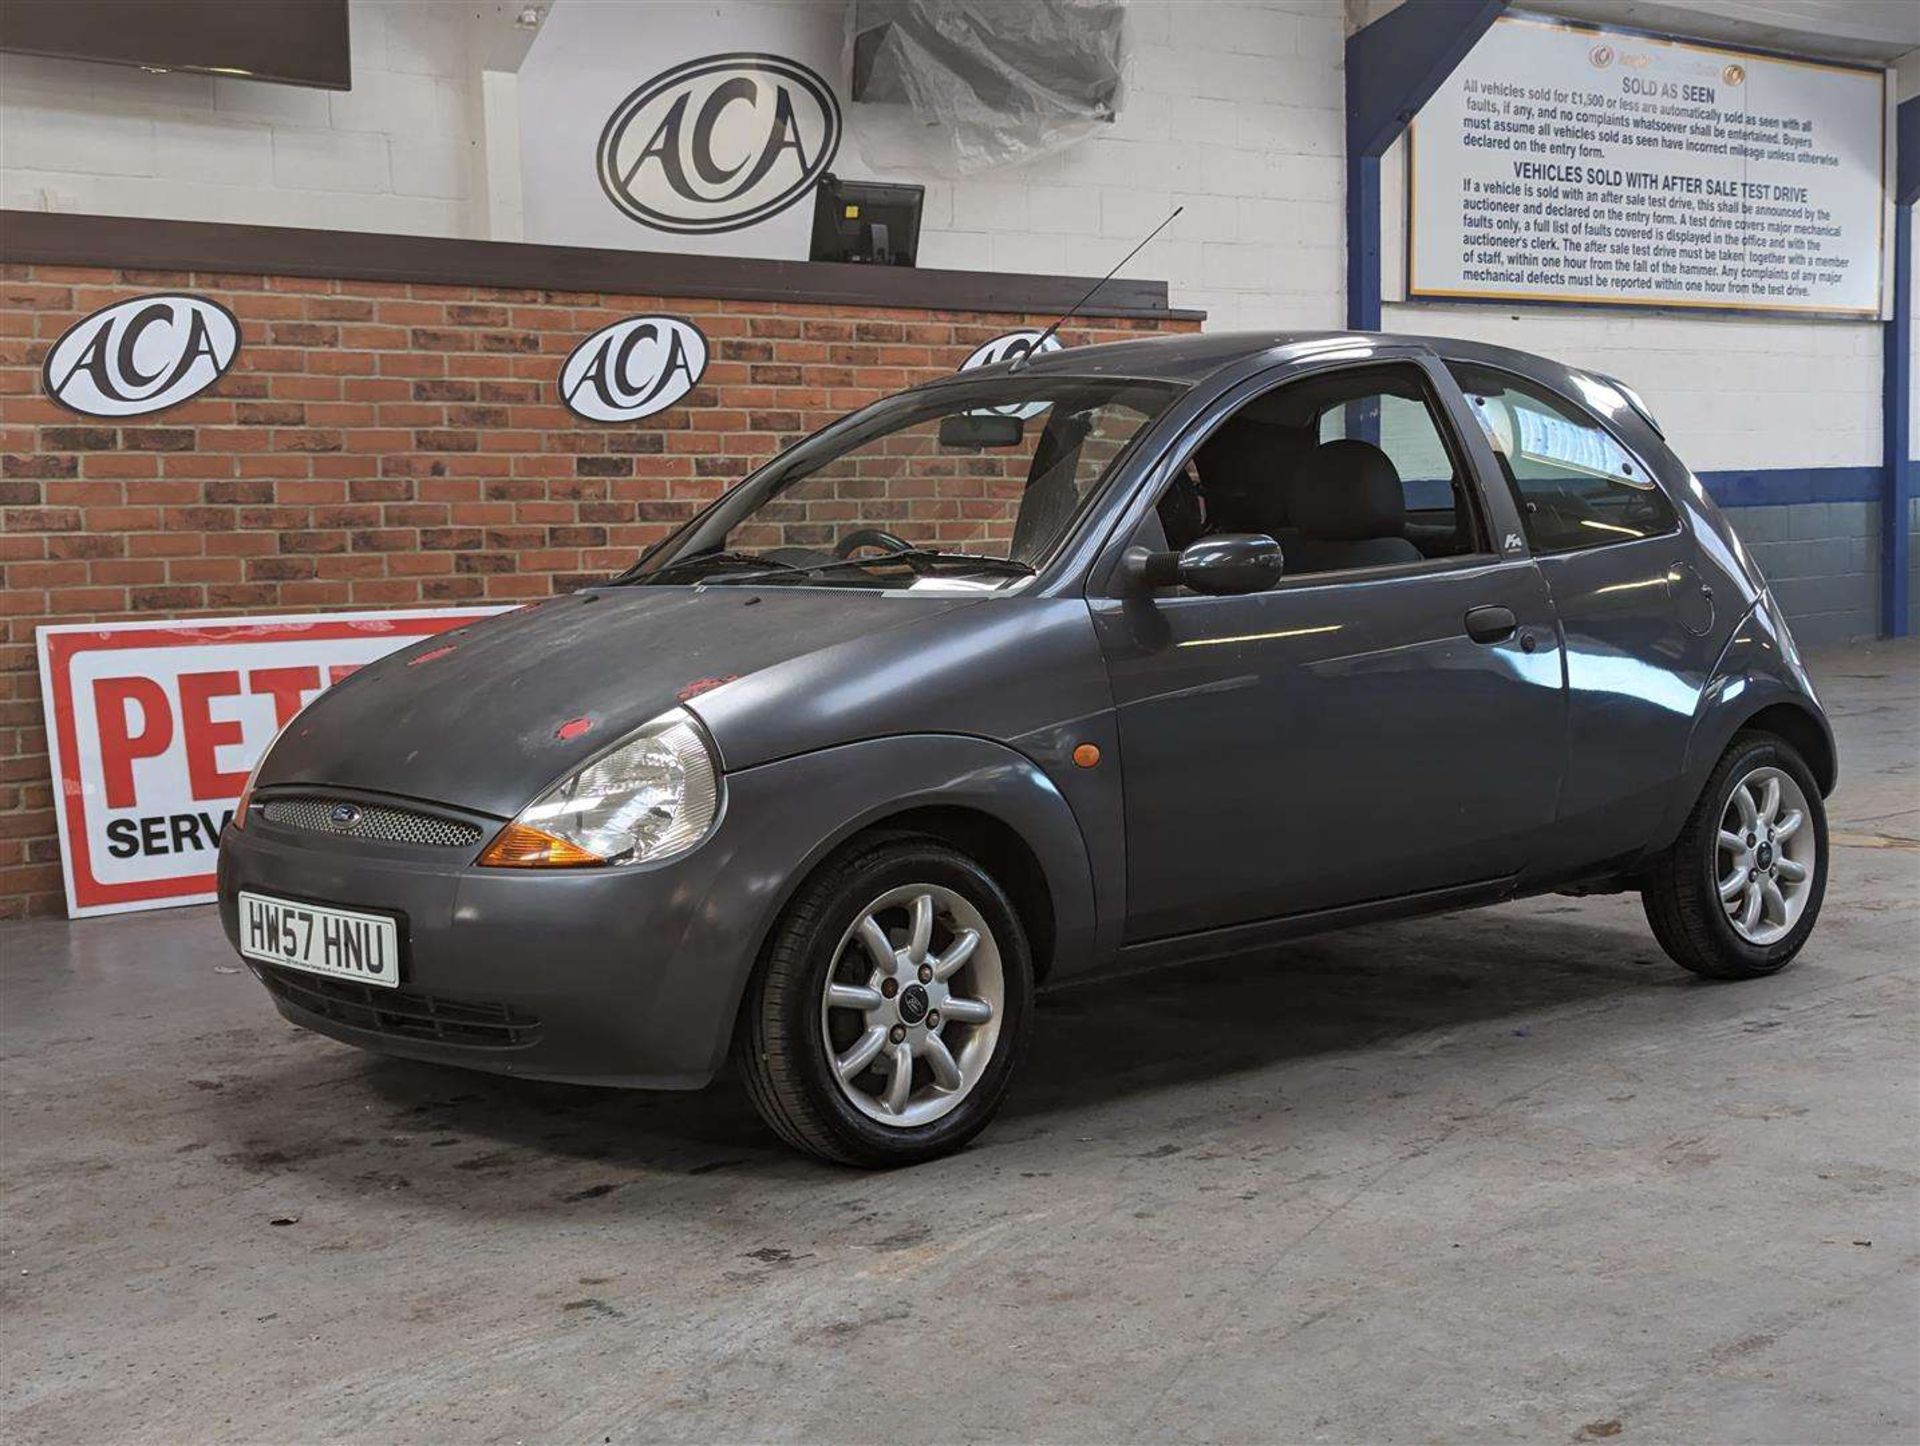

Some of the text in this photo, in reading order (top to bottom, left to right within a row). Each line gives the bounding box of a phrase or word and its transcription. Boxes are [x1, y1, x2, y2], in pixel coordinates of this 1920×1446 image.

[1463, 79, 1812, 132] All vehicles sold for £1,500 or less are automatically sold as seen with all
[1622, 76, 1714, 104] SOLD AS SEEN
[620, 77, 808, 203] ACA
[1463, 118, 1491, 131] must
[1492, 121, 1535, 135] assume
[1537, 123, 1551, 137] all
[1552, 125, 1596, 141] vehicles
[1597, 130, 1619, 144] sold
[1620, 134, 1634, 145] as
[1635, 136, 1659, 148] seen
[1660, 136, 1683, 150] have
[1685, 138, 1727, 154] incorrect
[1729, 144, 1765, 161] mileage
[1766, 148, 1795, 161] unless
[1466, 98, 1500, 116] faults,
[1502, 102, 1510, 115] if
[1512, 106, 1535, 121] any,
[1536, 107, 1557, 120] and
[1559, 111, 1573, 122] no
[1575, 112, 1630, 128] complaints
[1632, 117, 1687, 134] whatsoever
[1689, 123, 1711, 137] shall
[1713, 125, 1725, 138] be
[1782, 133, 1812, 149] Buyers
[1463, 133, 1605, 160] declared on the entry form.
[1463, 178, 1830, 222] If a vehicle is sold with an after sale test drive, this shall be announced by the
[1513, 161, 1807, 203] VEHICLES SOLD WITH AFTER SALE TEST DRIVE
[1462, 198, 1841, 236] auctioneer and declared on the entry form. A test drive covers major mechanical
[1463, 214, 1821, 250] faults only, a full list of faults covered is displayed in the office and with the
[1462, 234, 1528, 249] auctioneer's
[1530, 237, 1560, 251] clerk.
[1562, 238, 1582, 252] The
[1583, 240, 1607, 253] after
[1609, 242, 1630, 255] sale
[1631, 243, 1651, 256] test
[1652, 244, 1677, 257] drive
[1678, 247, 1702, 259] must
[1704, 247, 1717, 260] be
[1749, 250, 1785, 265] together
[1787, 252, 1806, 264] with
[1807, 256, 1813, 265] a
[1814, 255, 1849, 267] member
[1462, 251, 1842, 285] of staff, within one hour from the fall of the hammer. Any complaints of any major
[1462, 269, 1809, 296] mechanical defects must be reported within one hour from the test drive.
[56, 303, 222, 402] ACA
[567, 323, 694, 410] ACA
[92, 664, 366, 809] PET
[249, 901, 384, 974] HW57 HNU
